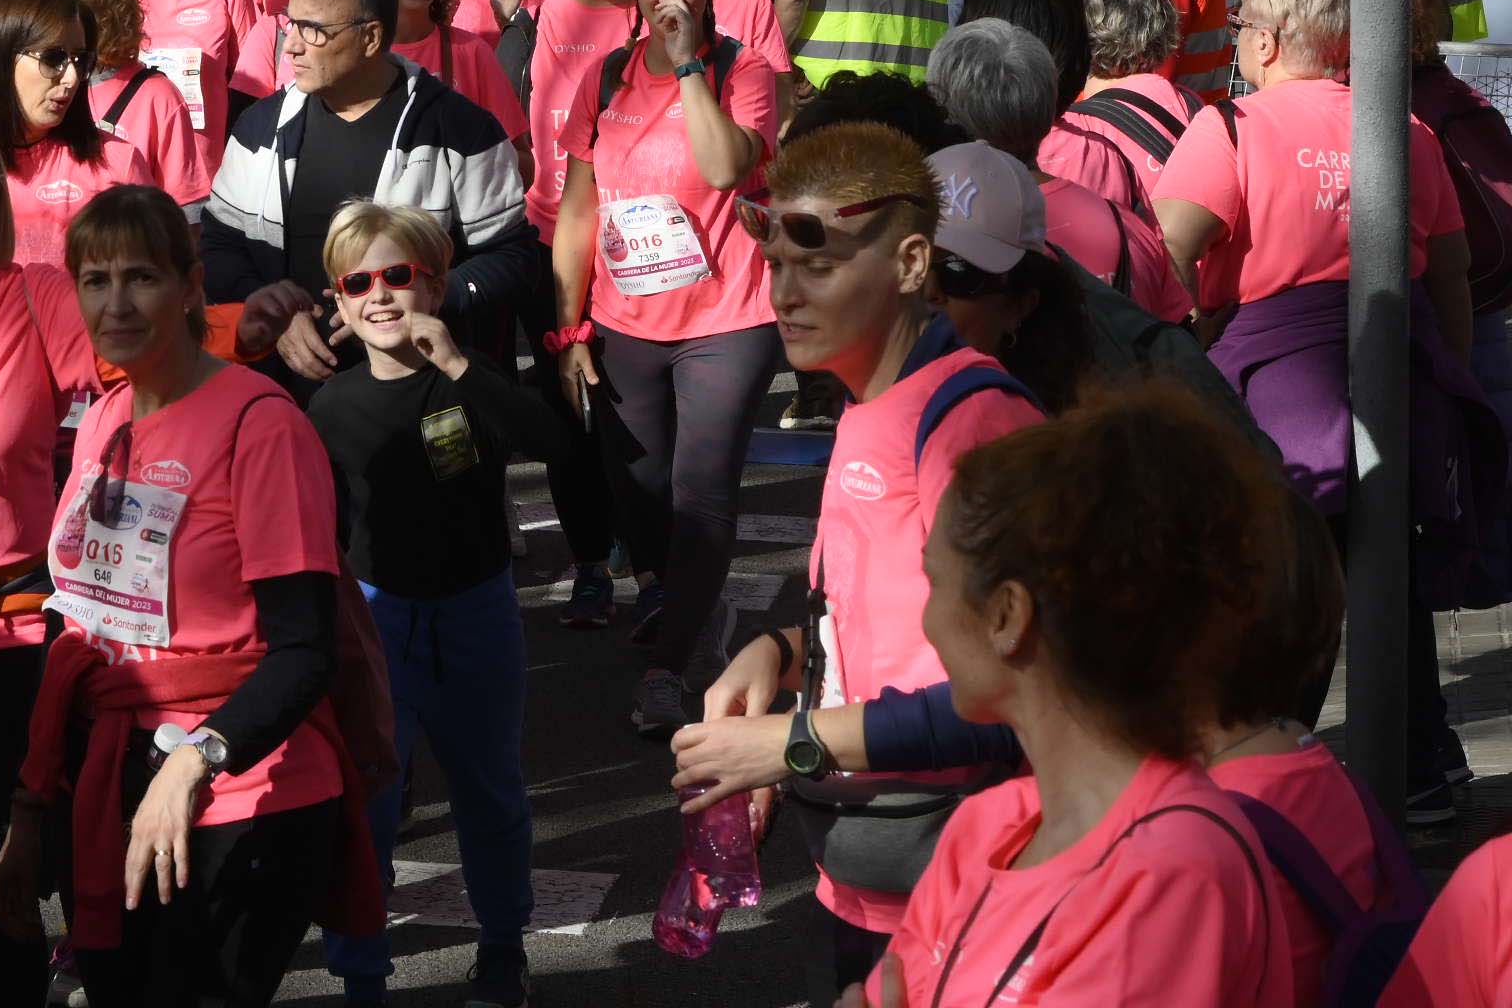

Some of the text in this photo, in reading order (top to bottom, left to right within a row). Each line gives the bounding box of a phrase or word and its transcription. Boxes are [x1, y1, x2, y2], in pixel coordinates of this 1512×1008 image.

[554, 43, 596, 54] OYSHO
[603, 111, 643, 125] OYSHO
[1297, 148, 1351, 170] CARR
[1320, 170, 1346, 190] DE
[621, 213, 659, 227] ASTURIANA
[629, 234, 663, 251] 016
[638, 252, 660, 263] 7359
[617, 267, 642, 277] CARRERA
[642, 265, 650, 273] DE
[650, 264, 658, 272] LA
[658, 261, 679, 271] MUJER
[106, 593, 130, 606] MUJER
[132, 600, 152, 610] 2023
[113, 616, 157, 633] Santander
